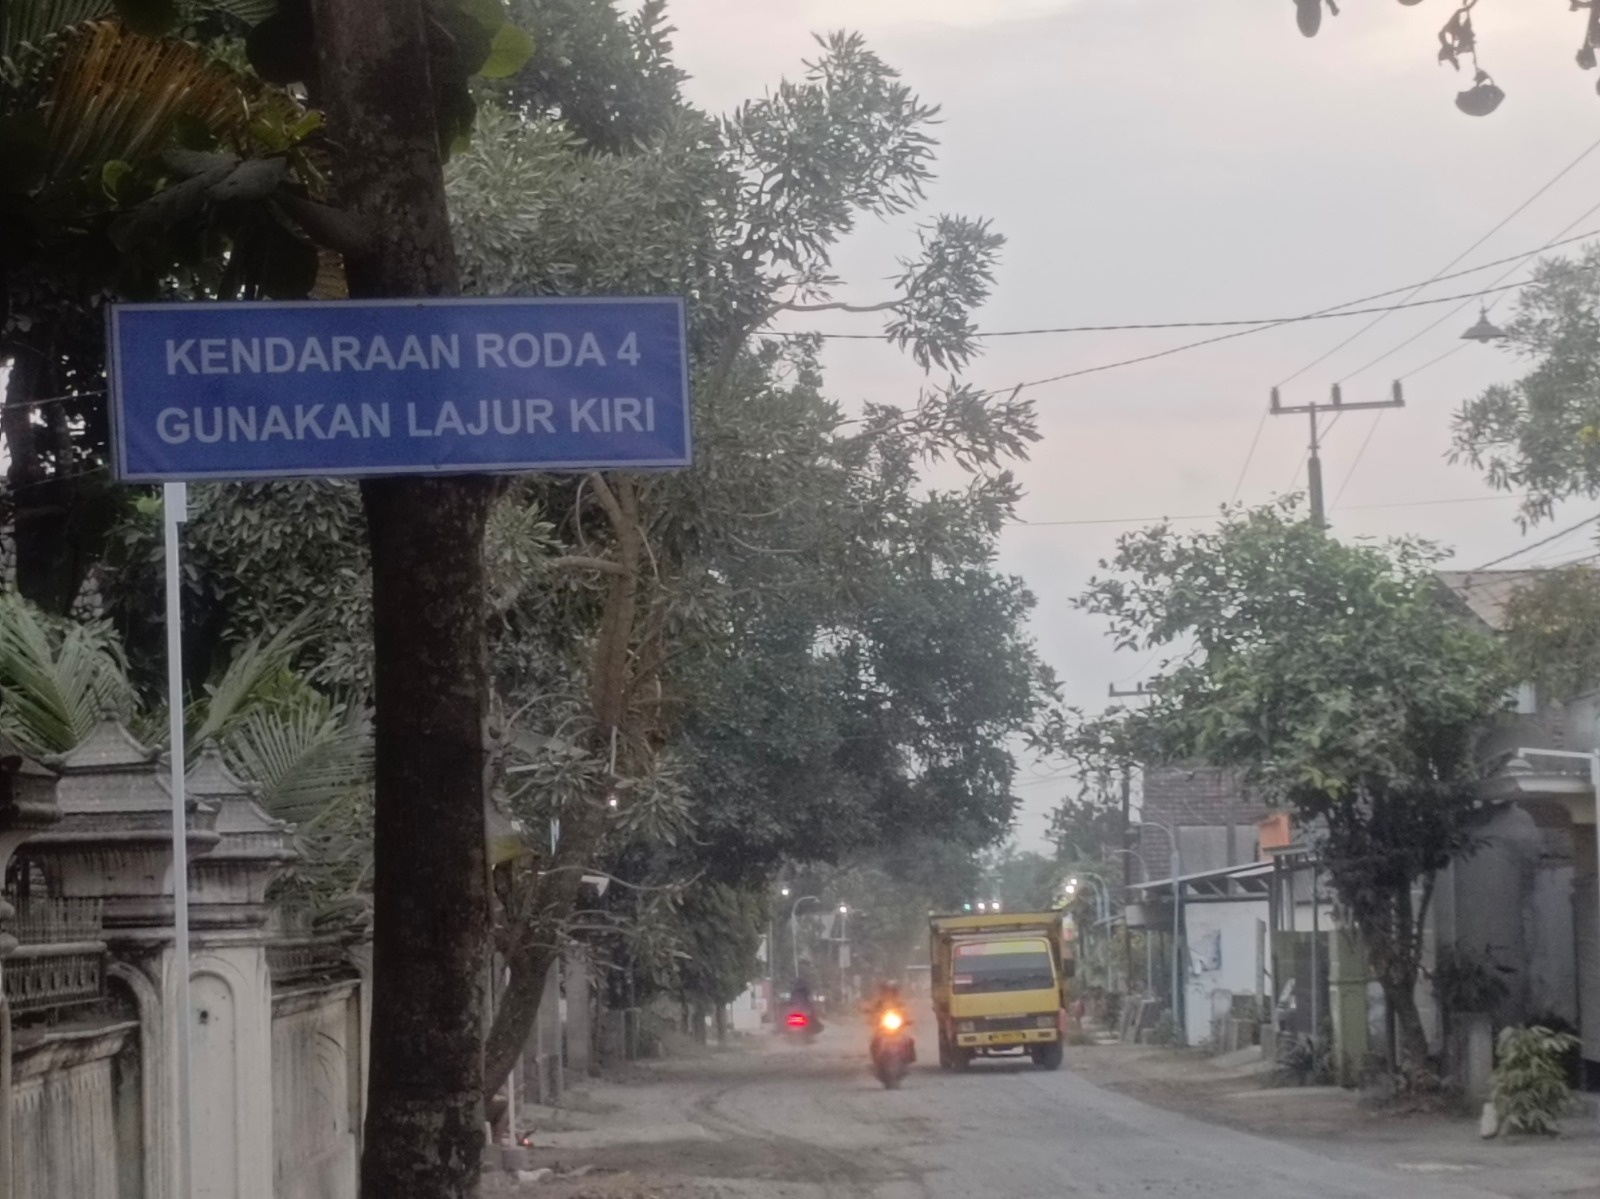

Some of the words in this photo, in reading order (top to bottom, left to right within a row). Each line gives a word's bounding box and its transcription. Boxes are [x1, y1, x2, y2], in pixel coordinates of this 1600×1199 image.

[166, 334, 461, 375] KENDARAAN
[476, 332, 607, 368] RODA
[616, 332, 641, 367] 4
[157, 403, 390, 444] GUNAKAN
[408, 399, 555, 437] LAJUR
[570, 397, 654, 433] KIRI
